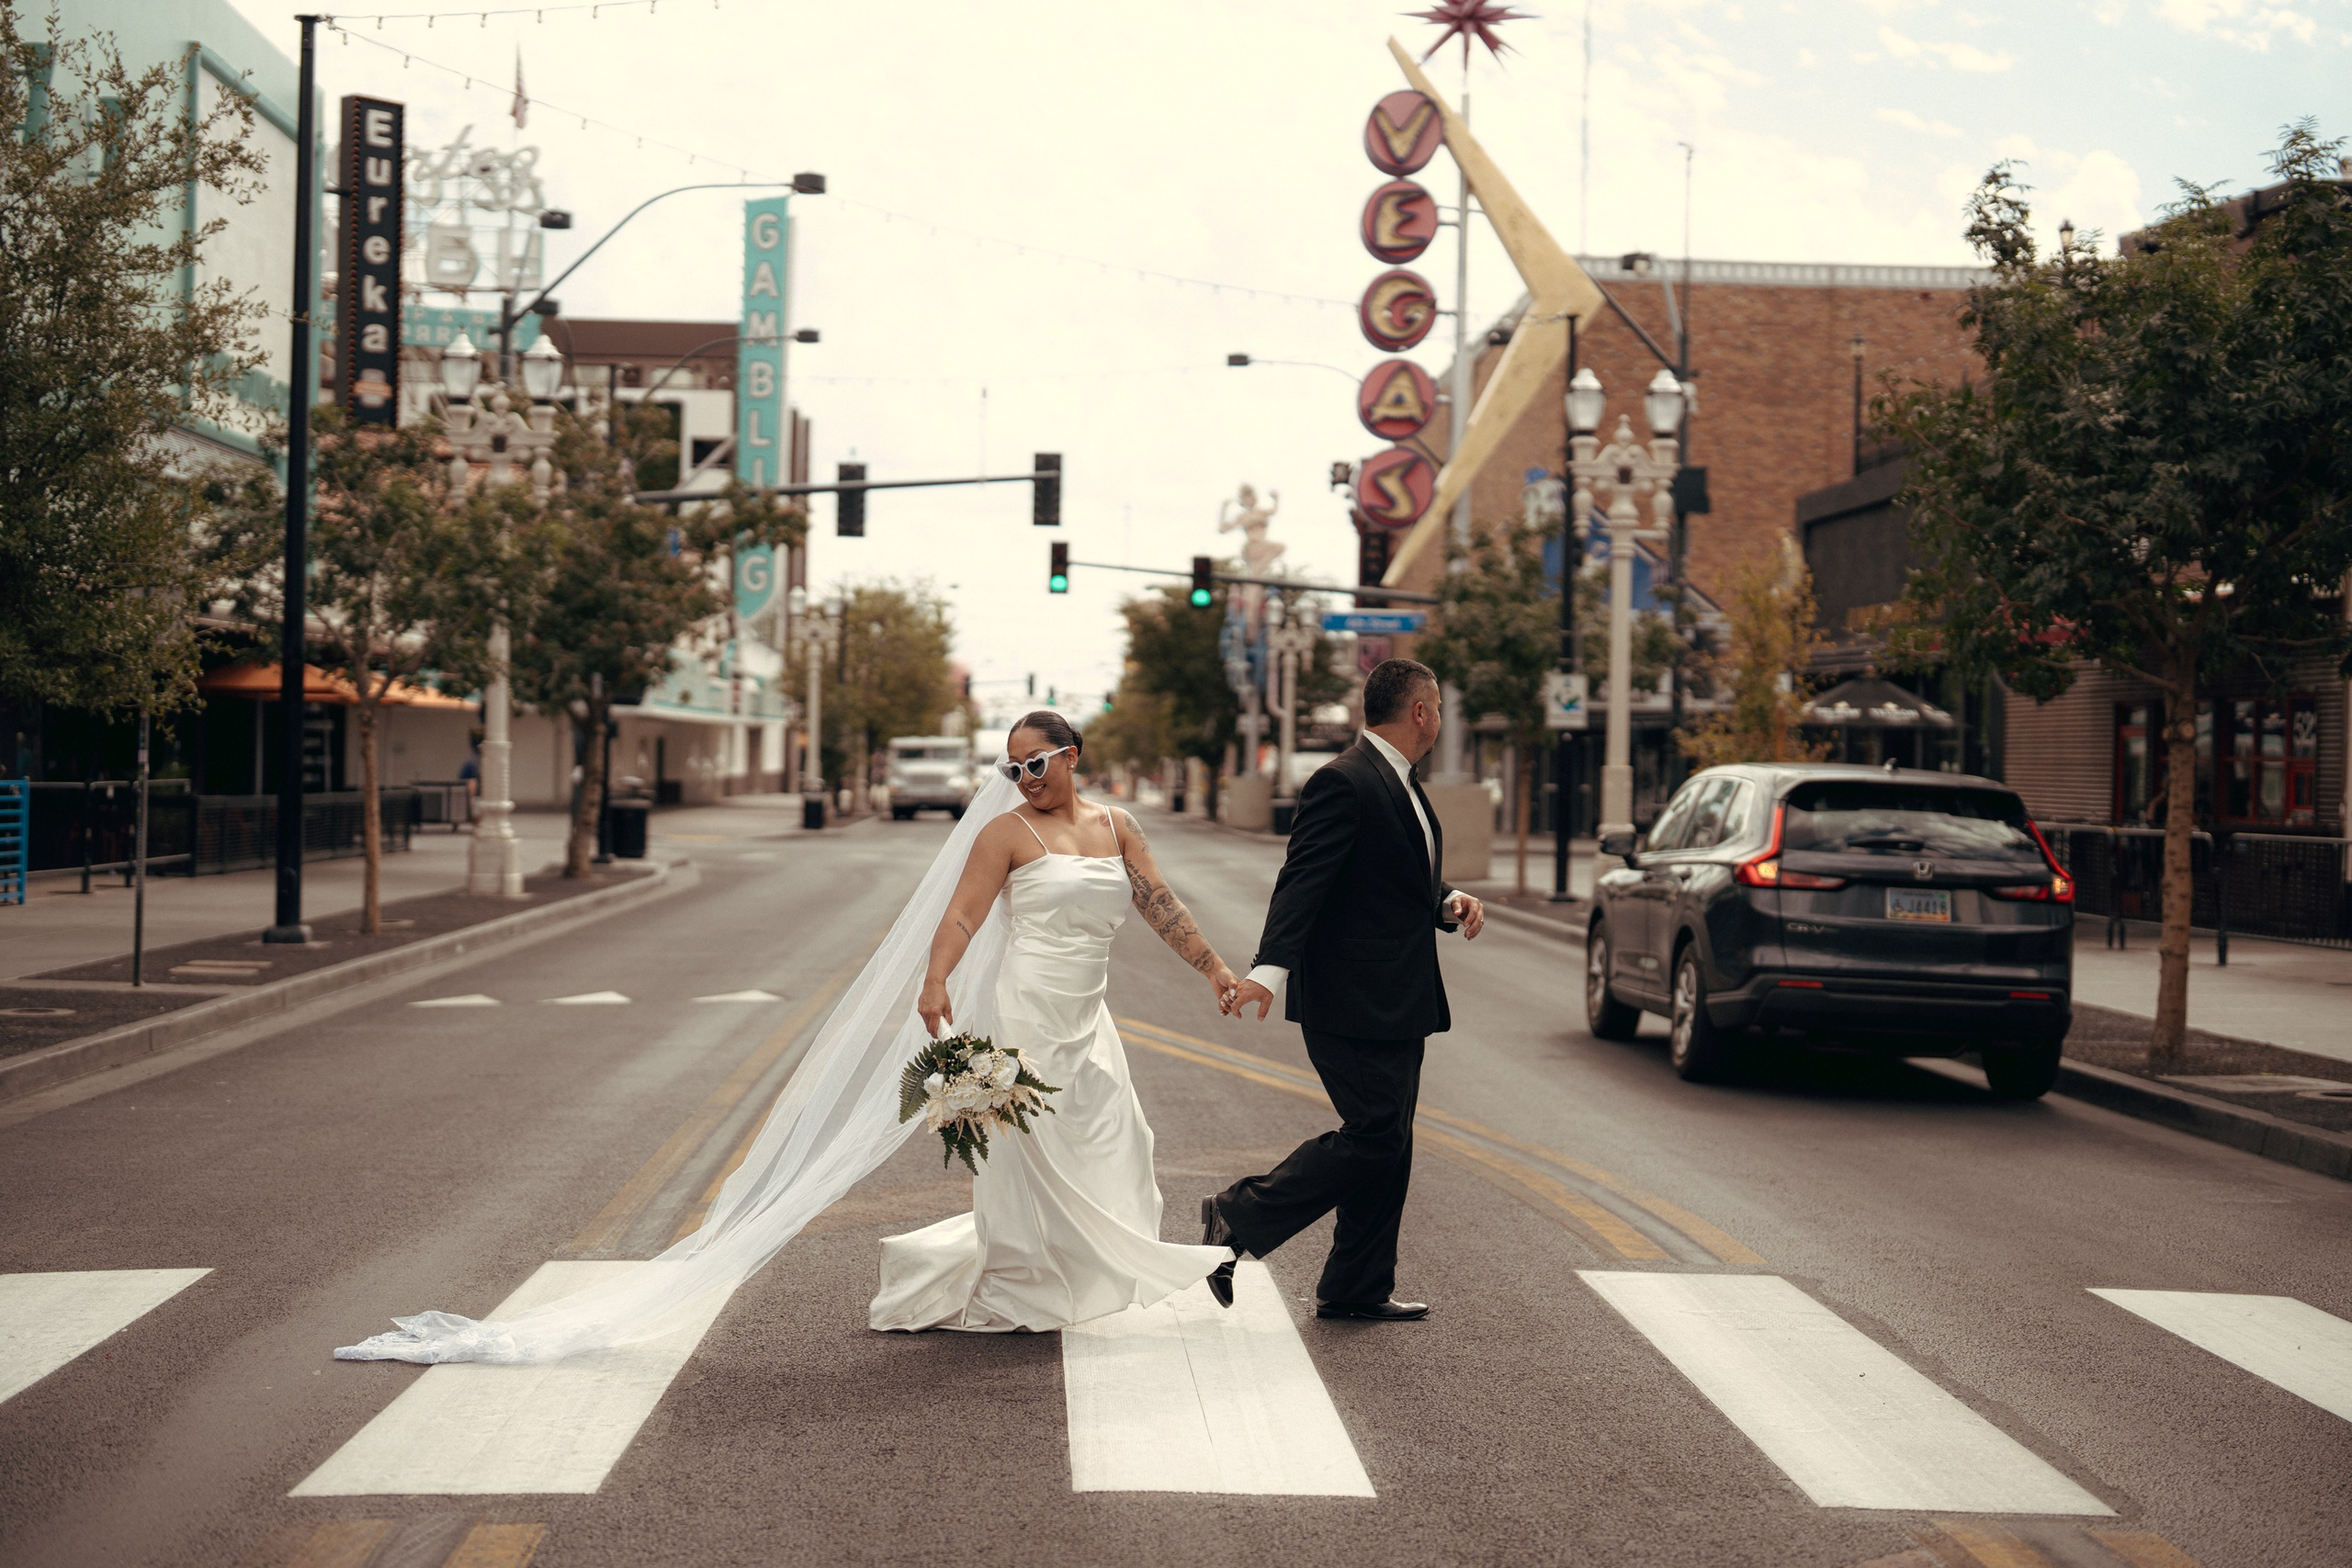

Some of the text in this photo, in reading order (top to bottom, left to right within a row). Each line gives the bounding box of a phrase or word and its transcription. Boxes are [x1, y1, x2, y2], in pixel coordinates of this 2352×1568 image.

[360, 107, 394, 354] Eureka
[741, 211, 781, 592] GAMBLIG
[1367, 98, 1438, 522] VEGAS
